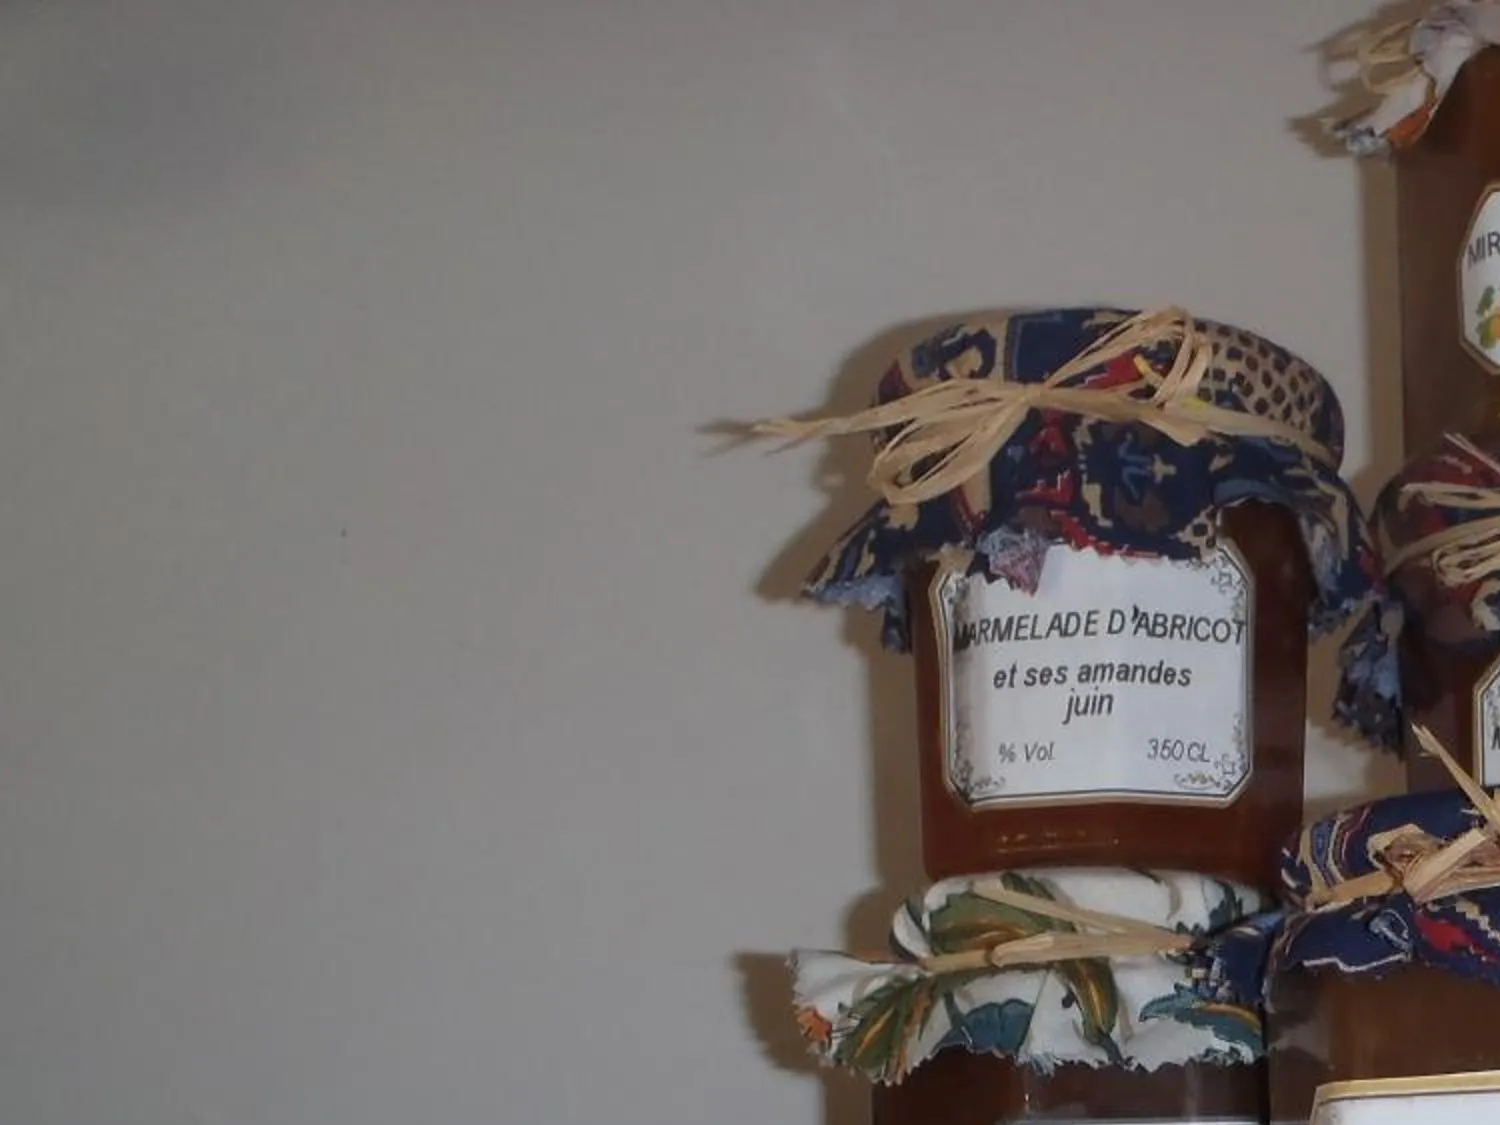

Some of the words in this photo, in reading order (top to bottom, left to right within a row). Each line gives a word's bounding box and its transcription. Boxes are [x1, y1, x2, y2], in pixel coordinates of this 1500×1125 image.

[993, 661, 1018, 688] et
[1023, 664, 1068, 688] ses
[1077, 661, 1192, 686] amandes
[1062, 685, 1113, 724] juin
